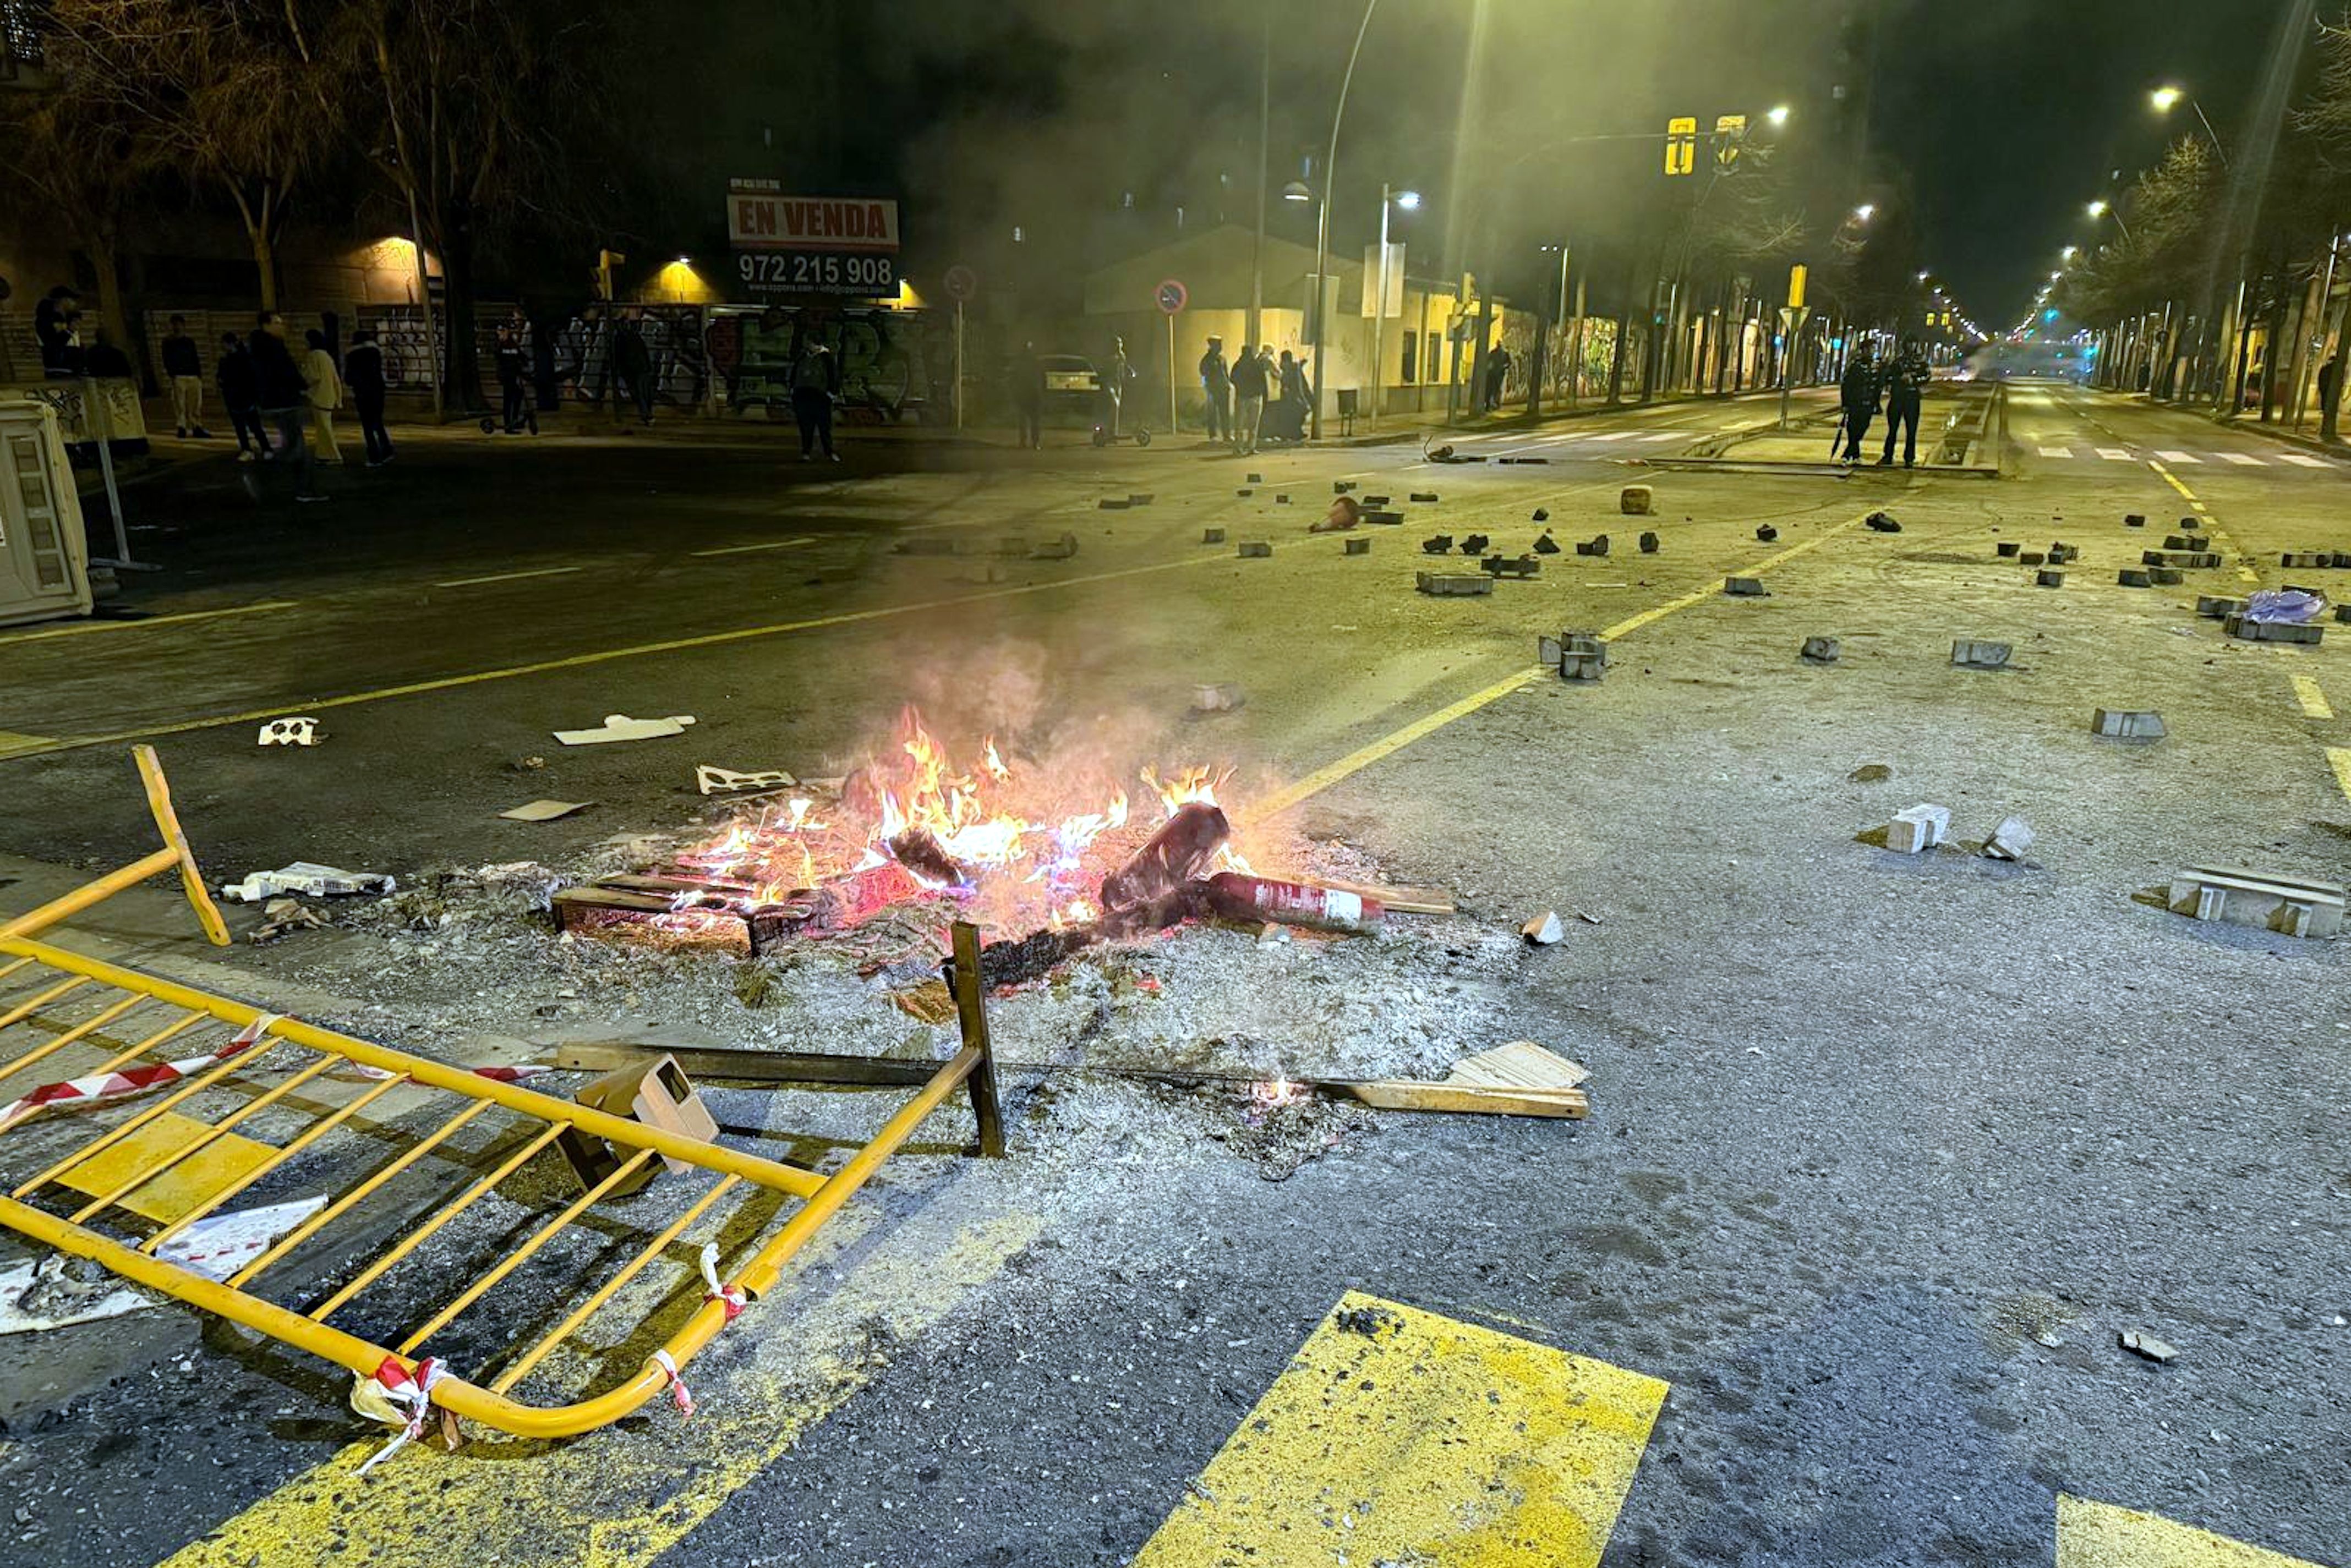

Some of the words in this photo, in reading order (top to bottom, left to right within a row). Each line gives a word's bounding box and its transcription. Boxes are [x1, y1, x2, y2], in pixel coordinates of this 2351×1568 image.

[738, 200, 775, 235] EN
[784, 202, 887, 238] VENDA
[739, 255, 786, 282] 972
[793, 256, 839, 284] 215
[847, 258, 892, 285] 908
